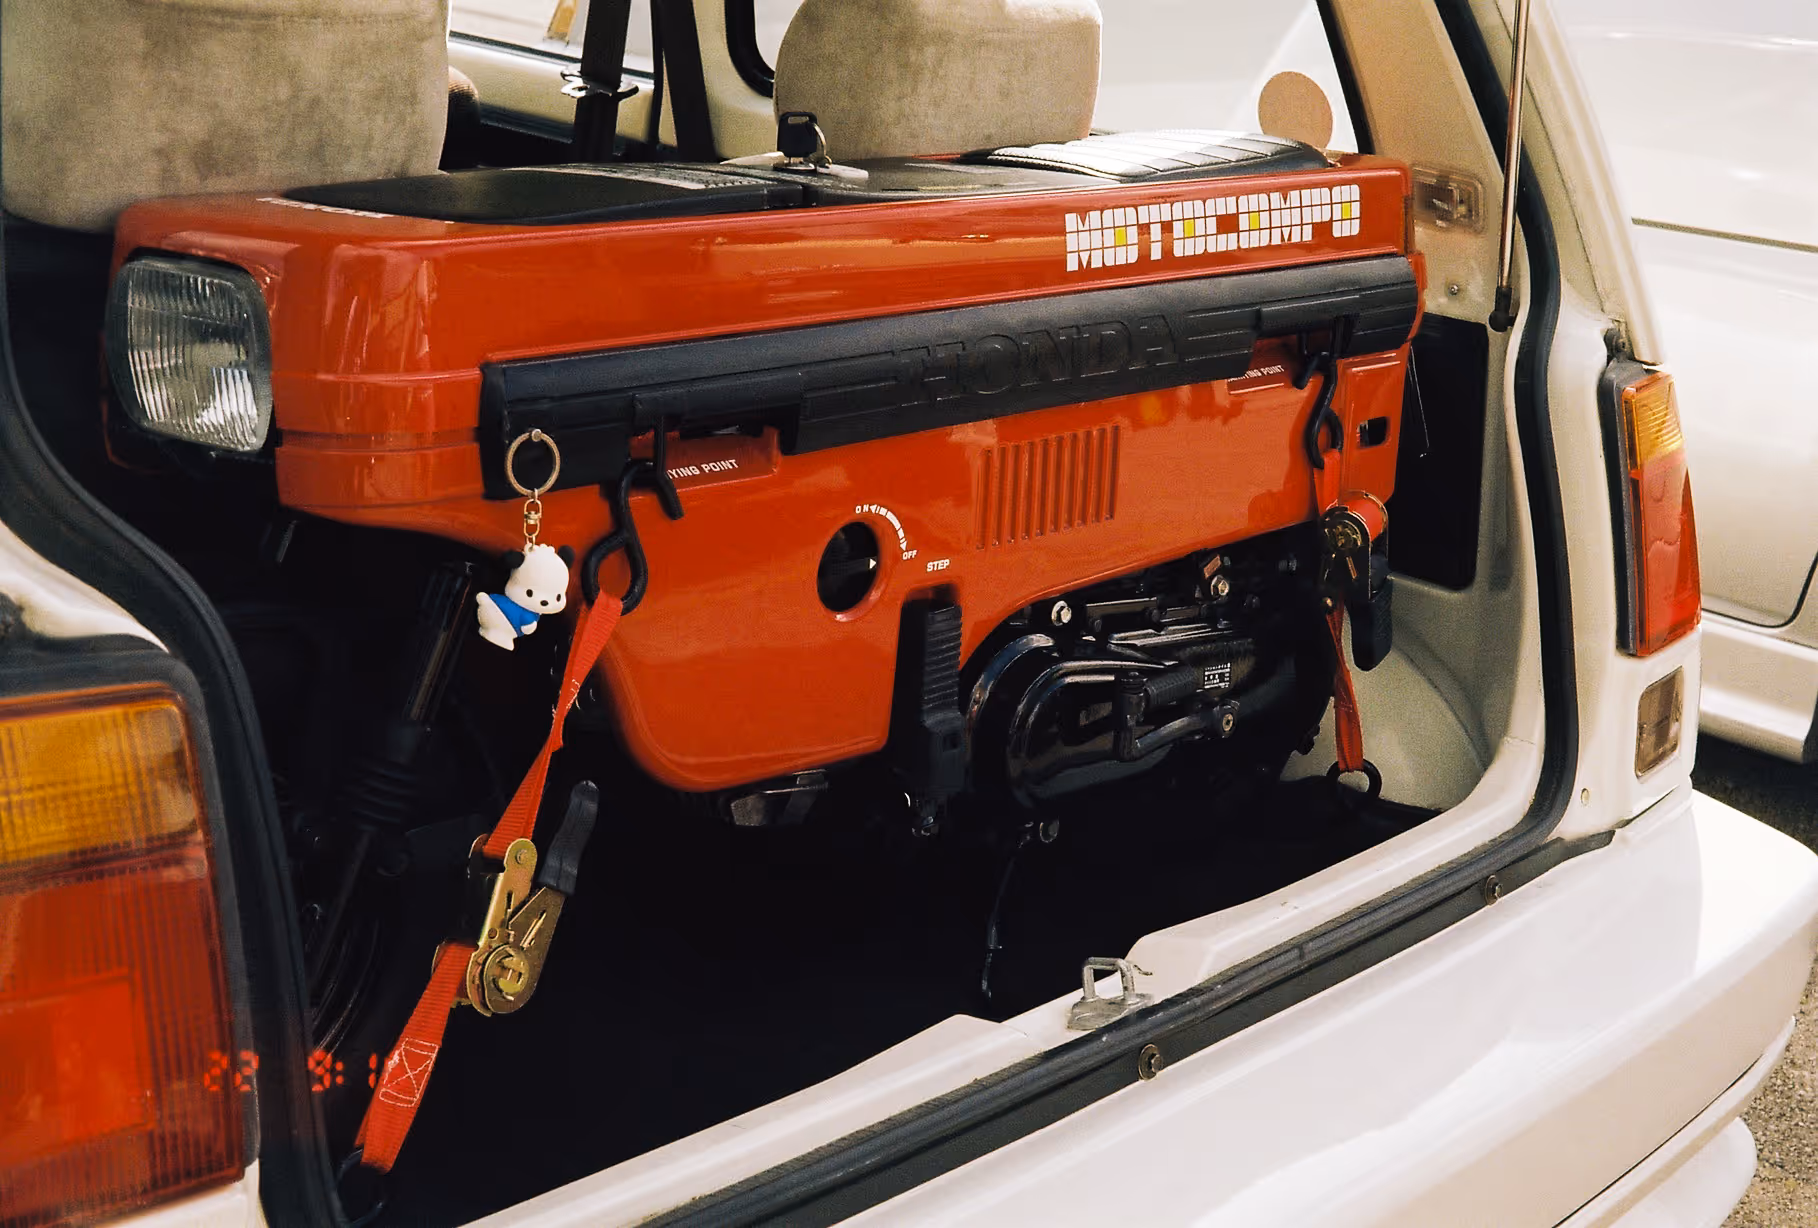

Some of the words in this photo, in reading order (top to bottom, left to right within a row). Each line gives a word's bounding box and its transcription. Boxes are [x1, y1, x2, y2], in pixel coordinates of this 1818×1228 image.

[1065, 184, 1361, 272] MOTOCOMPO
[898, 313, 1178, 408] HONDA
[1260, 364, 1284, 376] POINT
[666, 465, 701, 480] YING
[700, 459, 739, 474] POINT
[855, 503, 869, 515] ON
[902, 549, 918, 561] OFF
[926, 558, 950, 573] STEP
